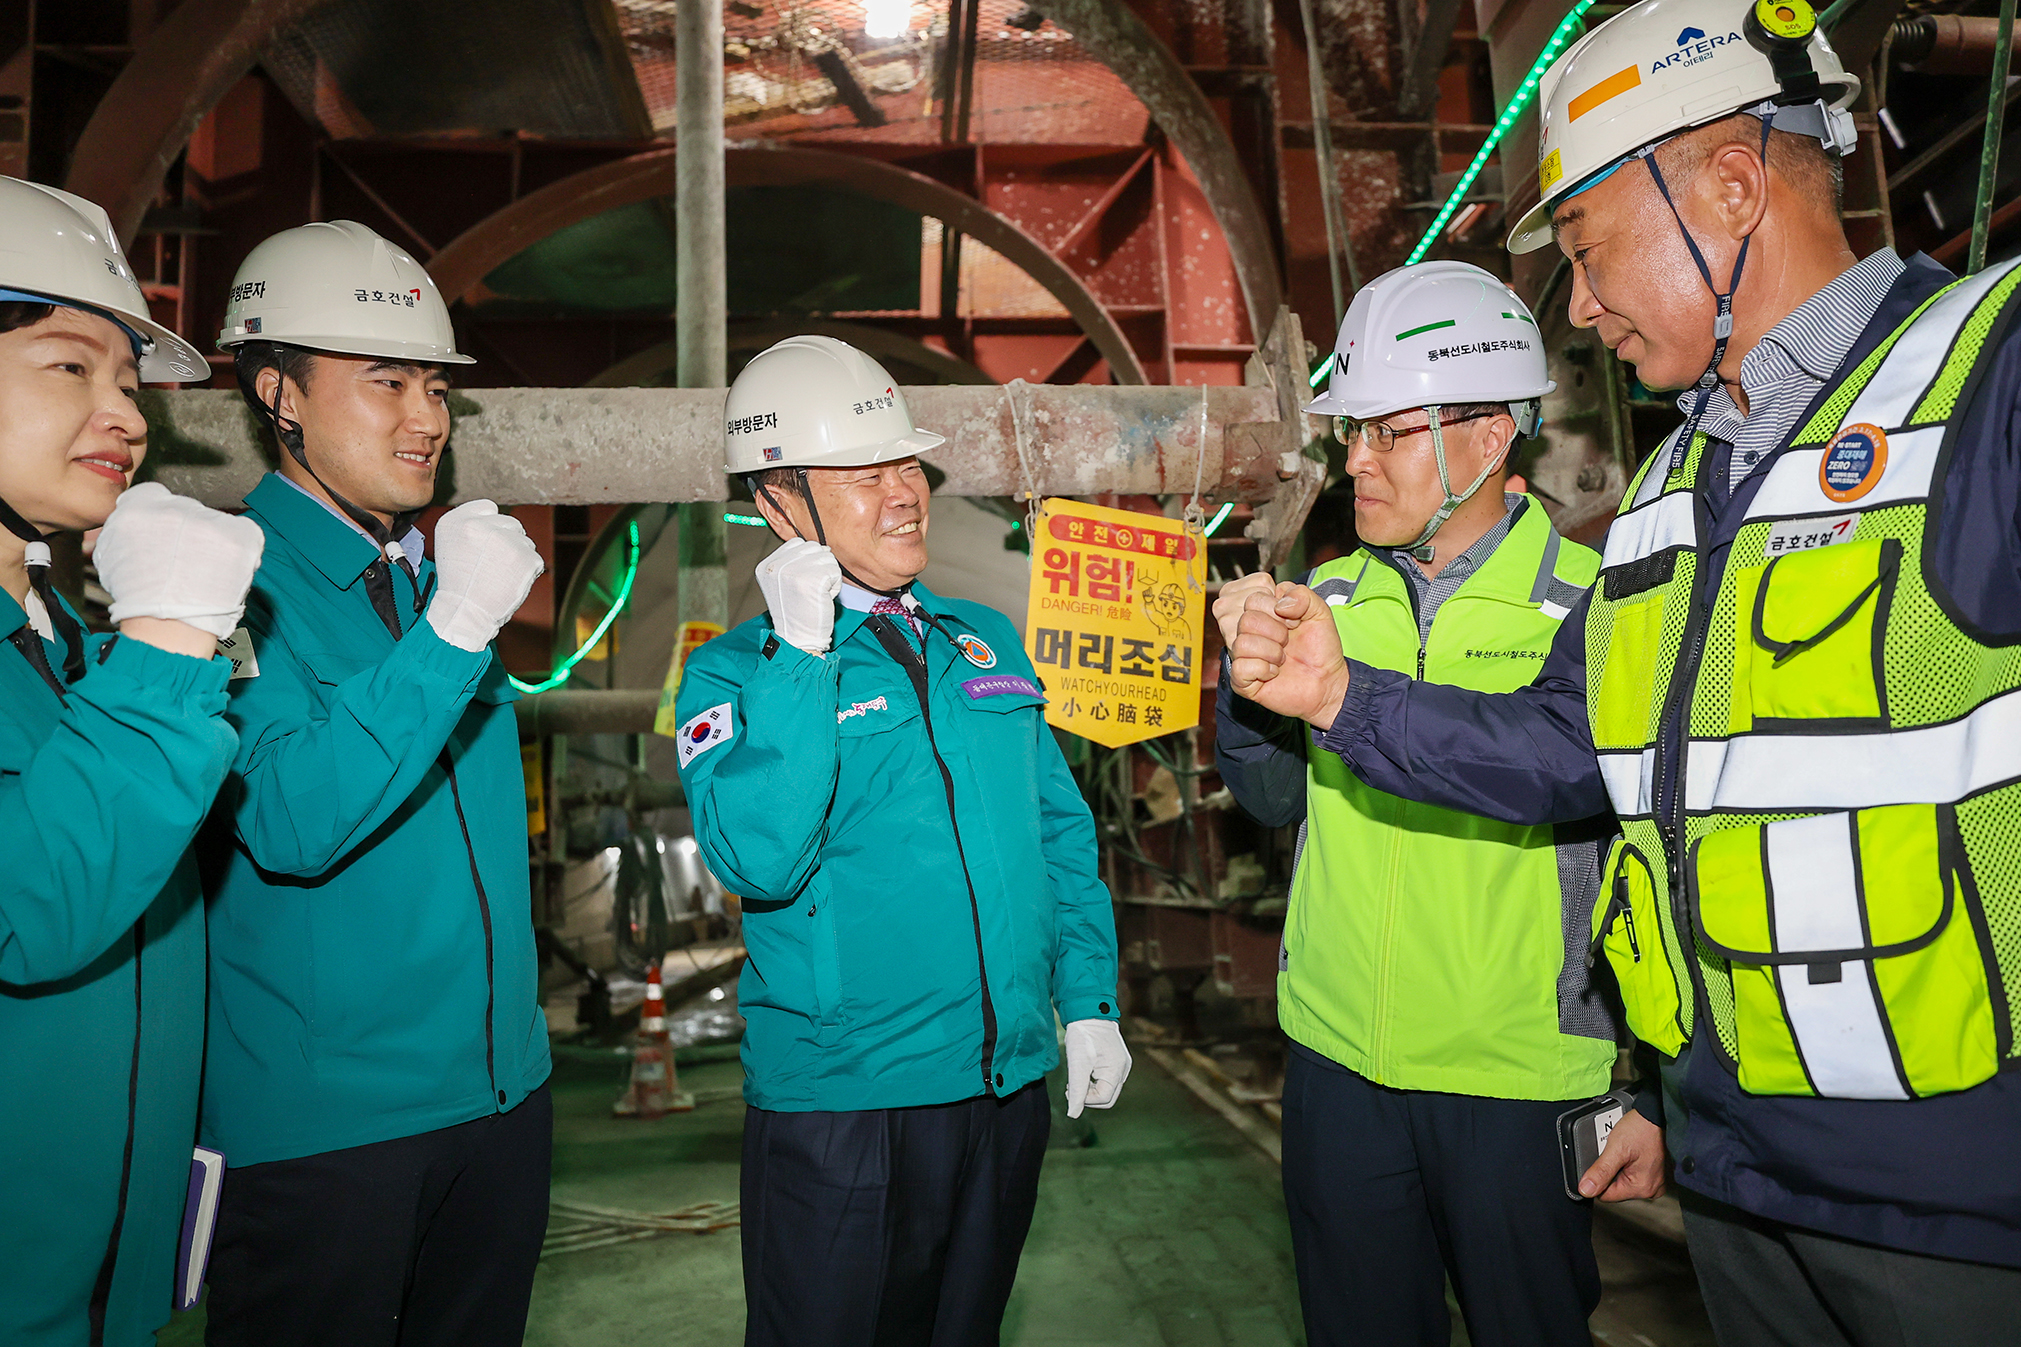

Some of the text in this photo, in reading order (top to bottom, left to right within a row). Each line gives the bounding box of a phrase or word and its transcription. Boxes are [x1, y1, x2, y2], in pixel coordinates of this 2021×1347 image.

[1651, 32, 1743, 75] ARTERA
[354, 289, 415, 308] 금호건설
[1428, 340, 1531, 362] 동북선도시철도주식회사
[1335, 352, 1351, 376] N
[853, 396, 894, 415] 금호건설
[727, 411, 778, 436] 외부방문자
[1681, 413, 1700, 446] SAFETY
[1827, 461, 1851, 471] ZERO
[1771, 531, 1834, 551] 금호건설
[1043, 547, 1135, 604] 위험!
[1041, 597, 1103, 616] DANGER!
[1034, 627, 1192, 685] 머리조심
[1060, 676, 1167, 702] WATCHYOURHEAD
